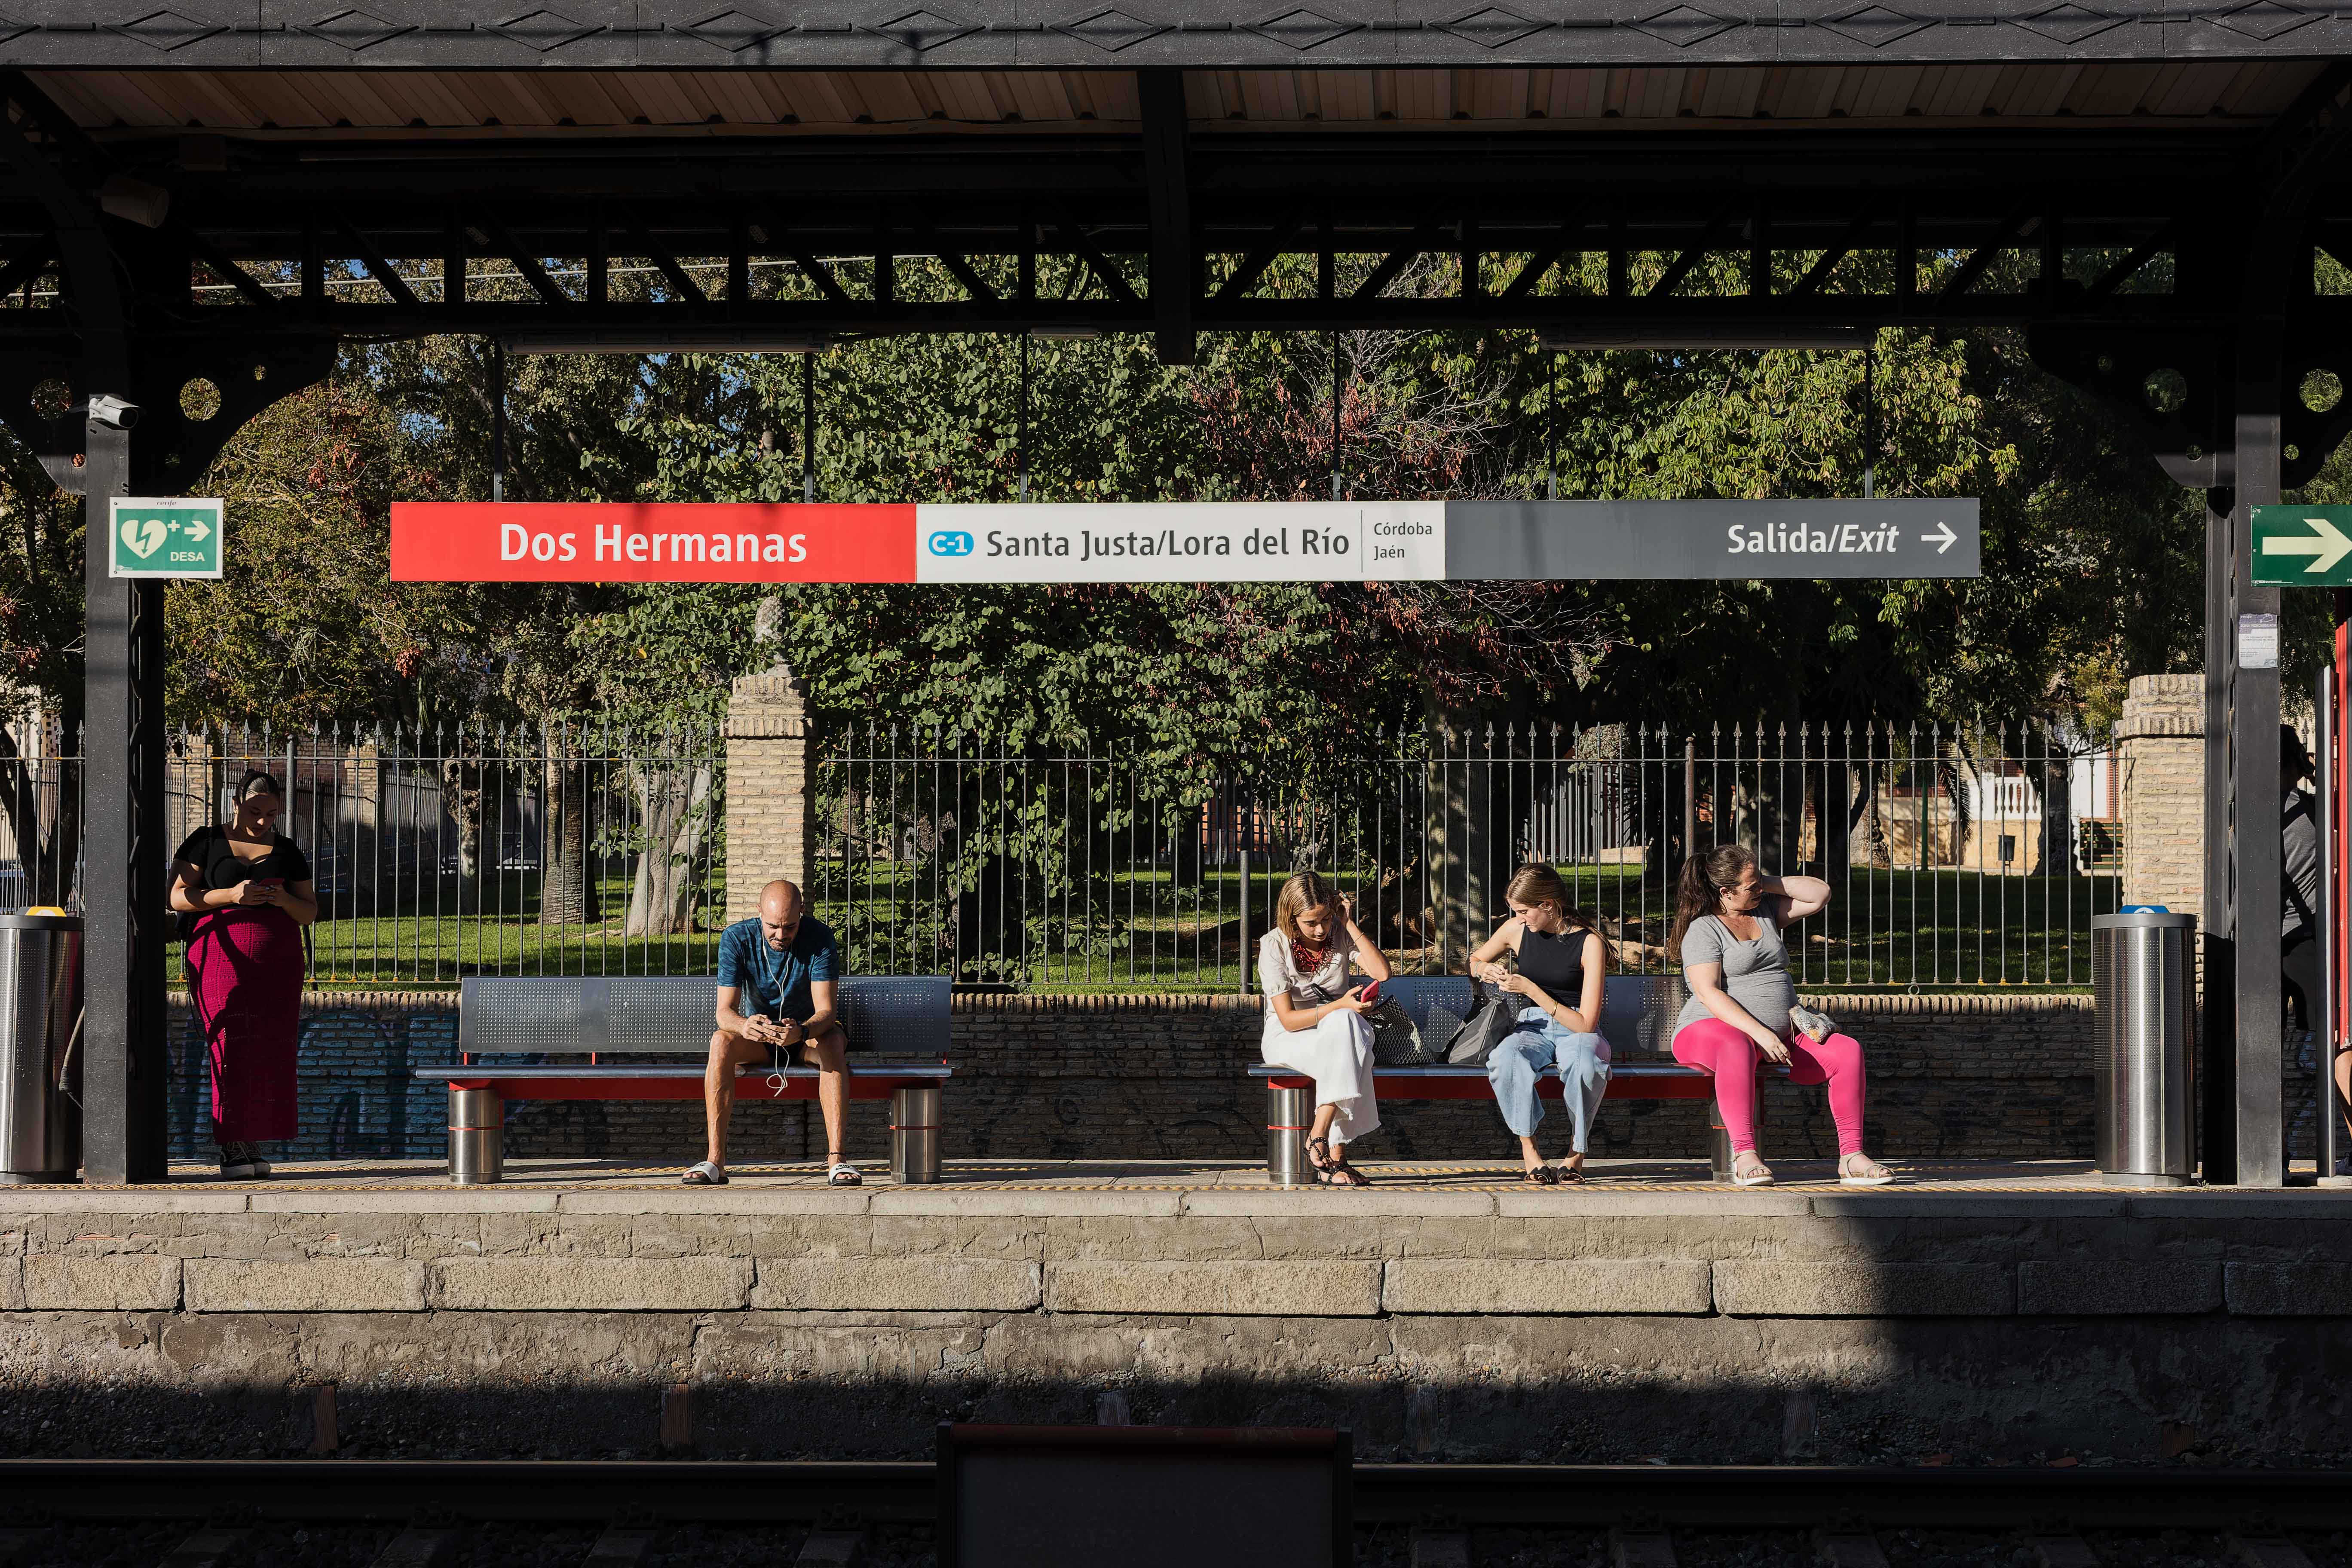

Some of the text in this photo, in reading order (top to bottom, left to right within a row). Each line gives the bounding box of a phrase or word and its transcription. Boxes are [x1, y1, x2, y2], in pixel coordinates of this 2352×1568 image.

[1374, 522, 1432, 535] Córdoba
[1728, 522, 1899, 553] Salida/Exit
[501, 524, 806, 562] Dos Hermanas
[931, 527, 1349, 561] C-1 Santa Justa/Lora del Río
[1374, 545, 1405, 560] Jaén
[170, 551, 205, 562] DESA
